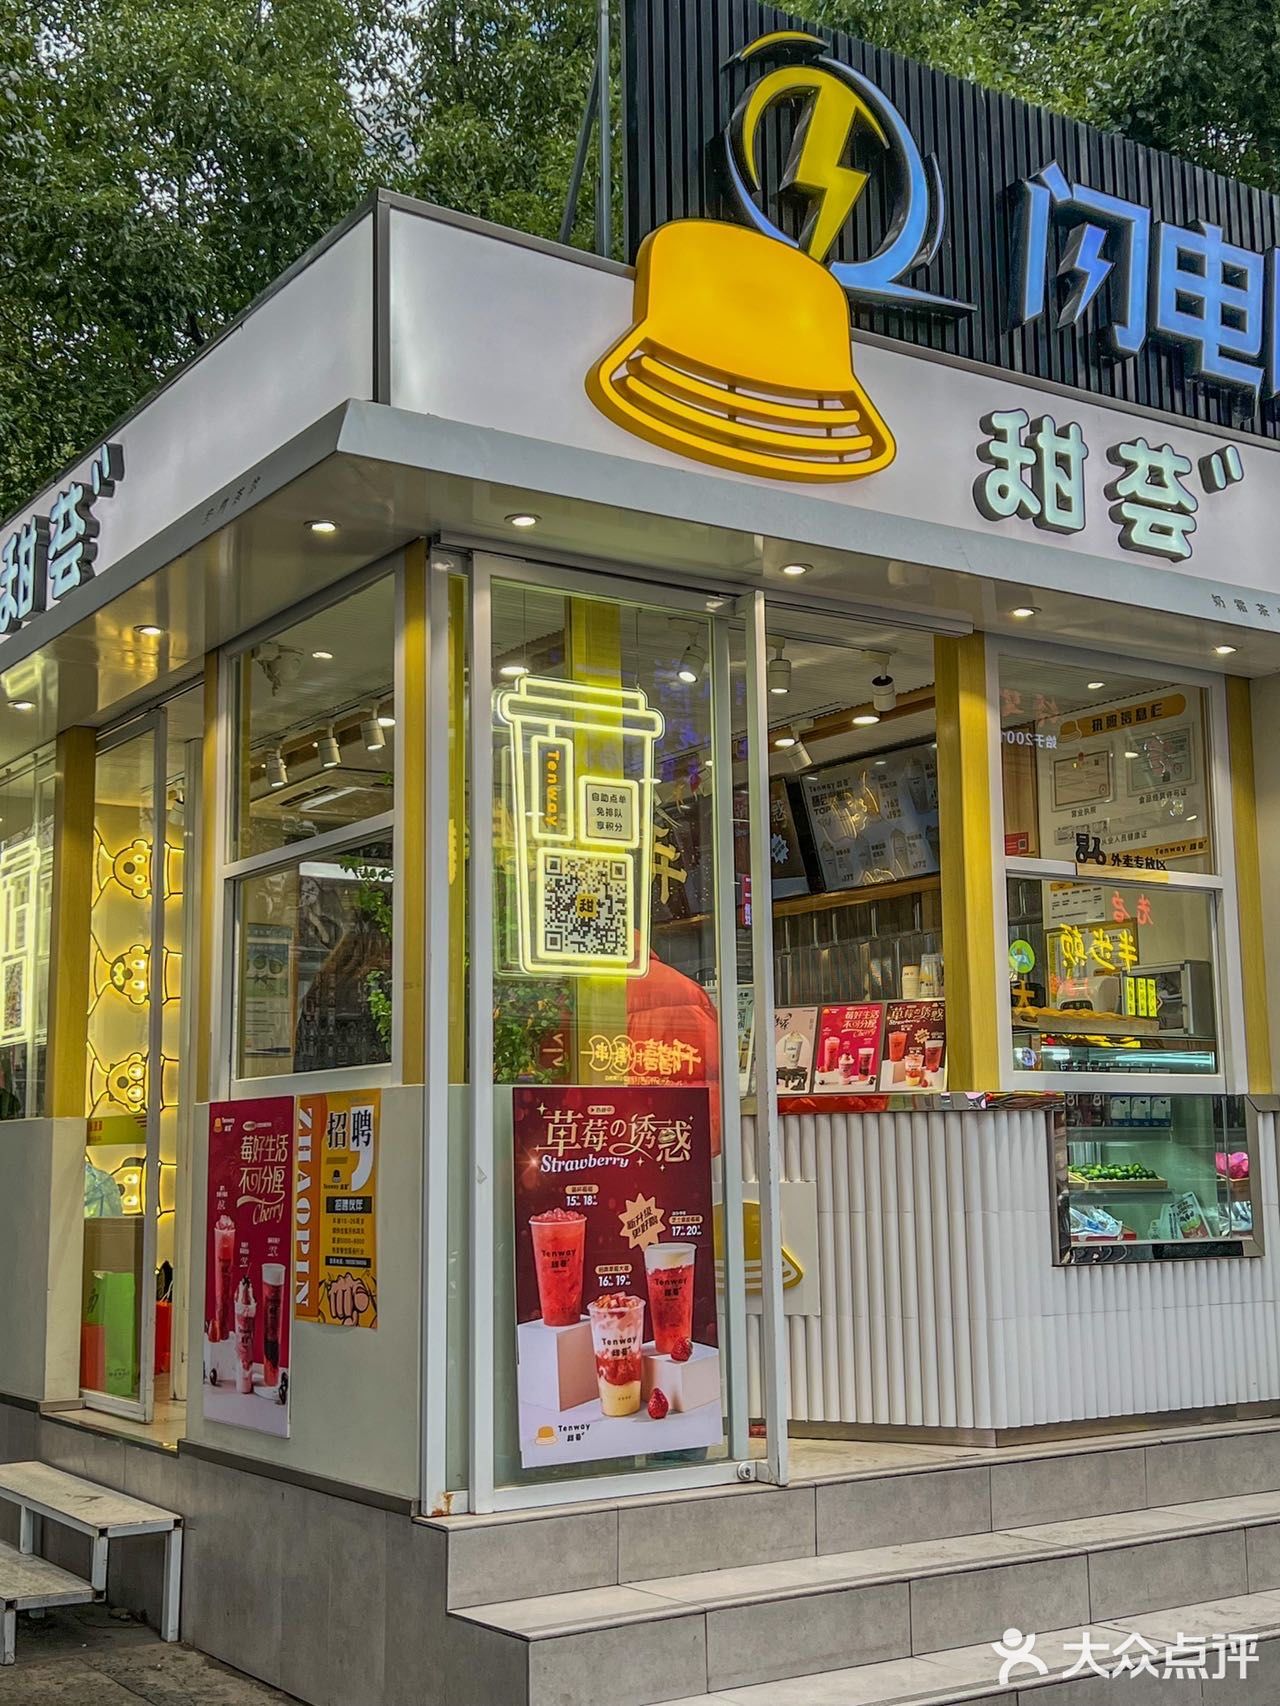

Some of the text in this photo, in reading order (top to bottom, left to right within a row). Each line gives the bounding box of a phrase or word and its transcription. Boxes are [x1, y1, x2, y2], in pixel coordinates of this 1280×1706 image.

[1018, 160, 1280, 400] 闪电
[1210, 593, 1280, 617] 奶霜茶
[544, 750, 560, 828] Tenway
[591, 792, 627, 804] 自助点单
[596, 806, 623, 818] 免排队
[596, 821, 623, 832] 享积分
[327, 1109, 372, 1148] 招聘
[541, 1110, 693, 1162] 草莓の诱惑
[540, 1153, 630, 1173] Strawberry
[252, 1198, 284, 1225] Cherry
[296, 1106, 313, 1307] ZHAOPIN
[541, 1249, 577, 1258] Tenway
[654, 1277, 687, 1286] Tenway
[601, 1335, 637, 1346] Tenway
[557, 1423, 591, 1432] Tenway
